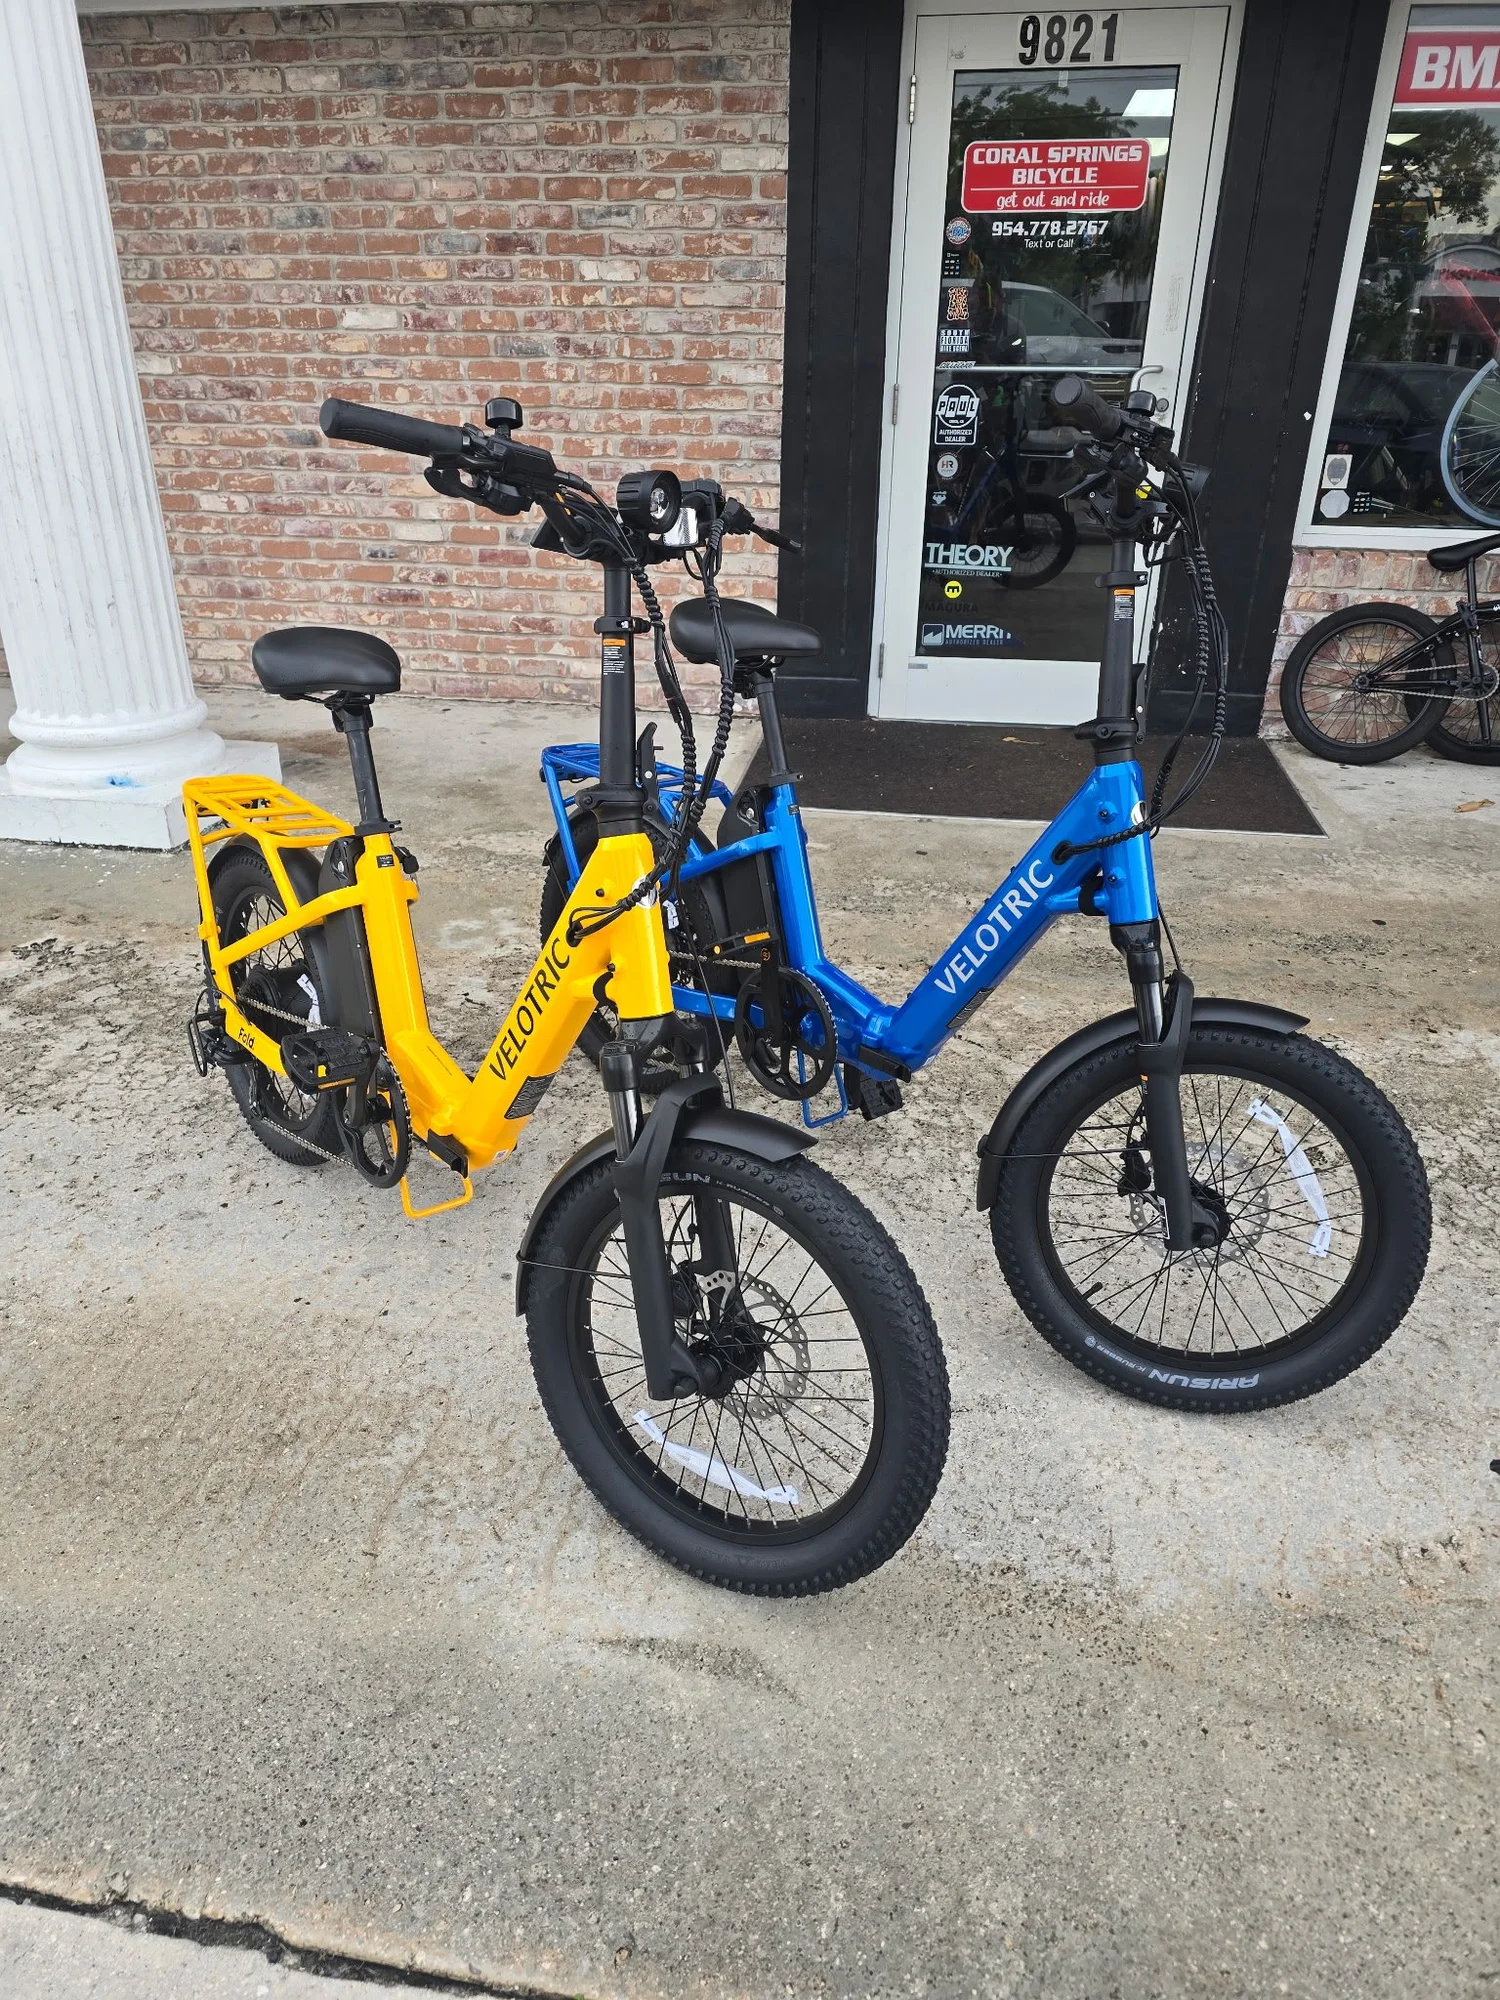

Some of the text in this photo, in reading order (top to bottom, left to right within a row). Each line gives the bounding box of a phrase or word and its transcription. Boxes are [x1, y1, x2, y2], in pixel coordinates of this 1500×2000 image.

[1018, 13, 1118, 65] 9821
[1410, 45, 1500, 89] BM
[972, 145, 1143, 164] CORAL SPRINGS
[1012, 167, 1098, 185] BICYCLE
[996, 190, 1110, 210] get out and ride
[991, 220, 1109, 236] 954.778.2767
[1024, 238, 1074, 248] Text or Call
[937, 397, 979, 415] PAUL
[926, 542, 1014, 567] THEORY
[934, 568, 975, 576] AUTHORIZED
[924, 601, 980, 613] MAGURA
[934, 859, 1054, 993] VELOTRIC
[489, 937, 570, 1080] VELOTRIC
[1149, 1368, 1260, 1390] ARISUN
